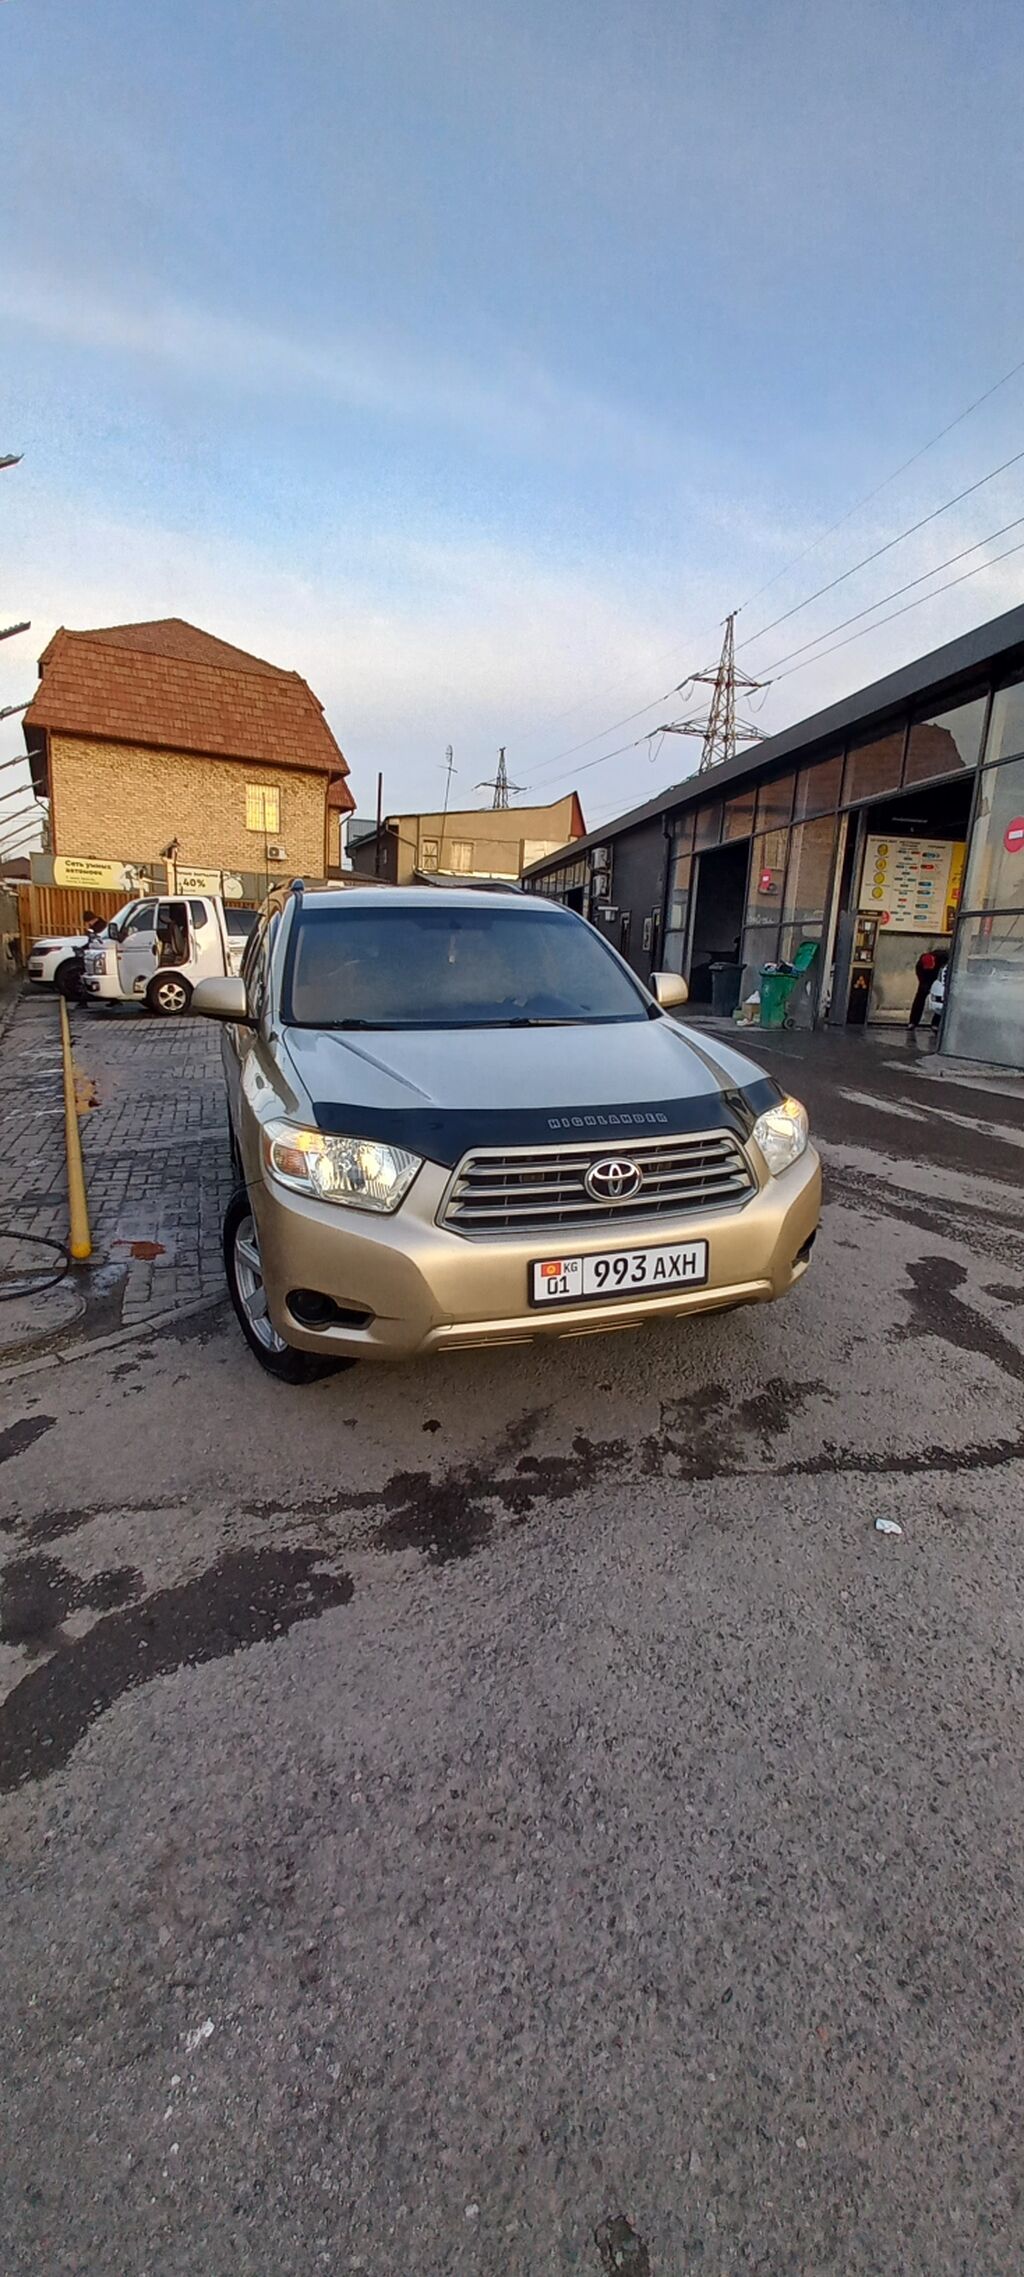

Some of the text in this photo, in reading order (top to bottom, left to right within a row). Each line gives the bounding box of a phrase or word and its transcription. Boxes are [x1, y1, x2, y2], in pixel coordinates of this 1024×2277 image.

[65, 860, 84, 868] Сеть
[547, 1112, 669, 1129] HIGHLANDER
[563, 1262, 578, 1274] KG
[594, 1252, 697, 1288] 993 AXH
[547, 1277, 570, 1295] 01
